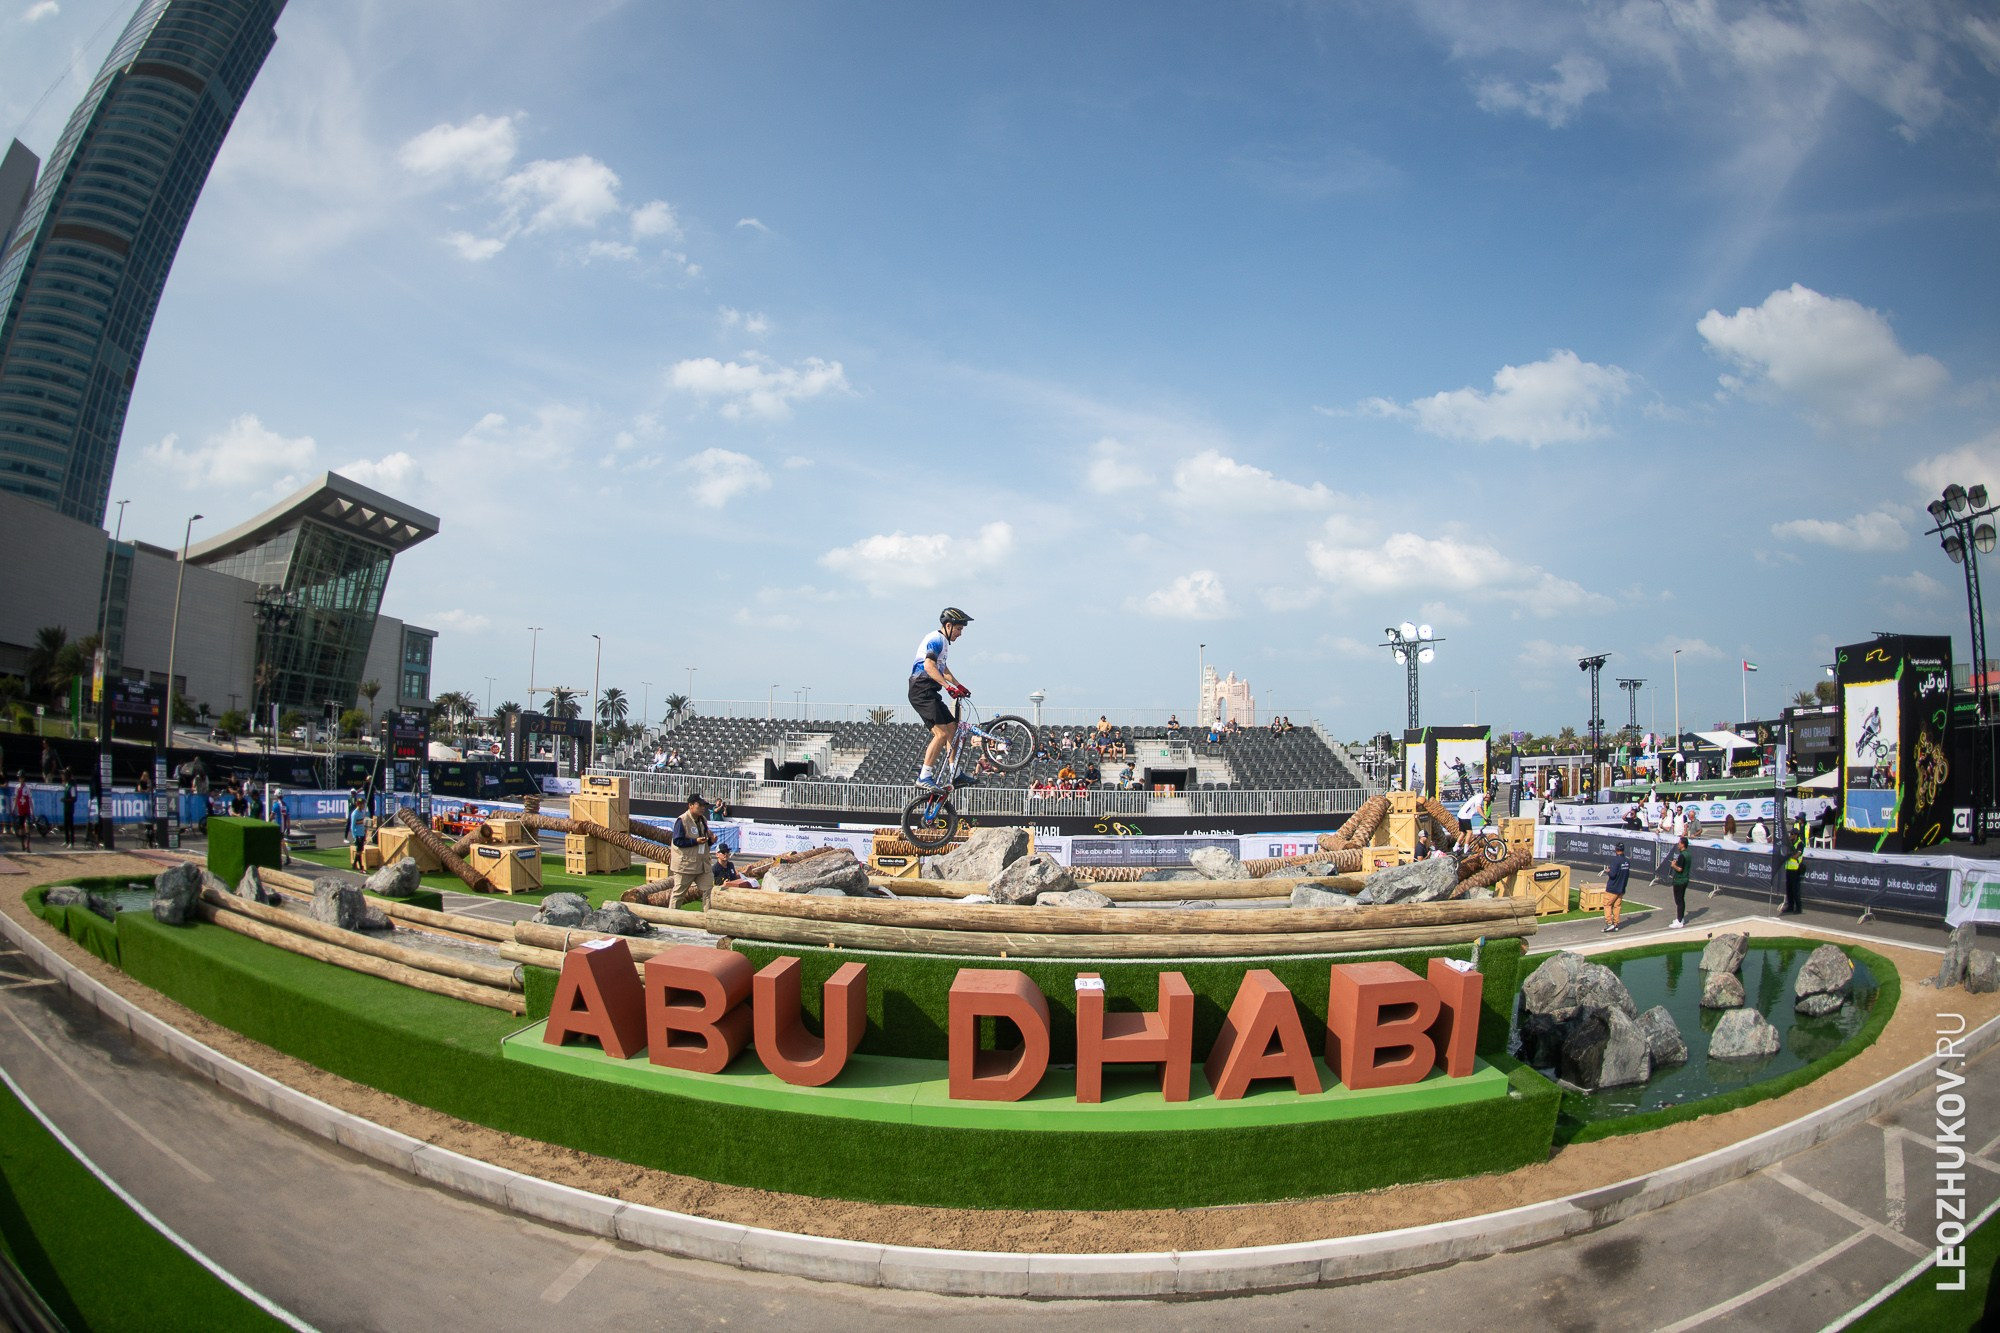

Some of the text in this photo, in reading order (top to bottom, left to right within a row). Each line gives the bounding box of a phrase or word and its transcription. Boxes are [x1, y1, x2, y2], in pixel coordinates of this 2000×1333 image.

[1919, 670, 1948, 698] أبو ظبي
[1717, 858, 1730, 866] Dhabi
[1758, 864, 1772, 872] Dhab
[1810, 872, 1829, 881] dhabi
[1834, 873, 1880, 887] bike abu dhabi
[1887, 878, 1937, 892] bike abu dhabi
[543, 938, 1484, 1104] ABU DHABI
